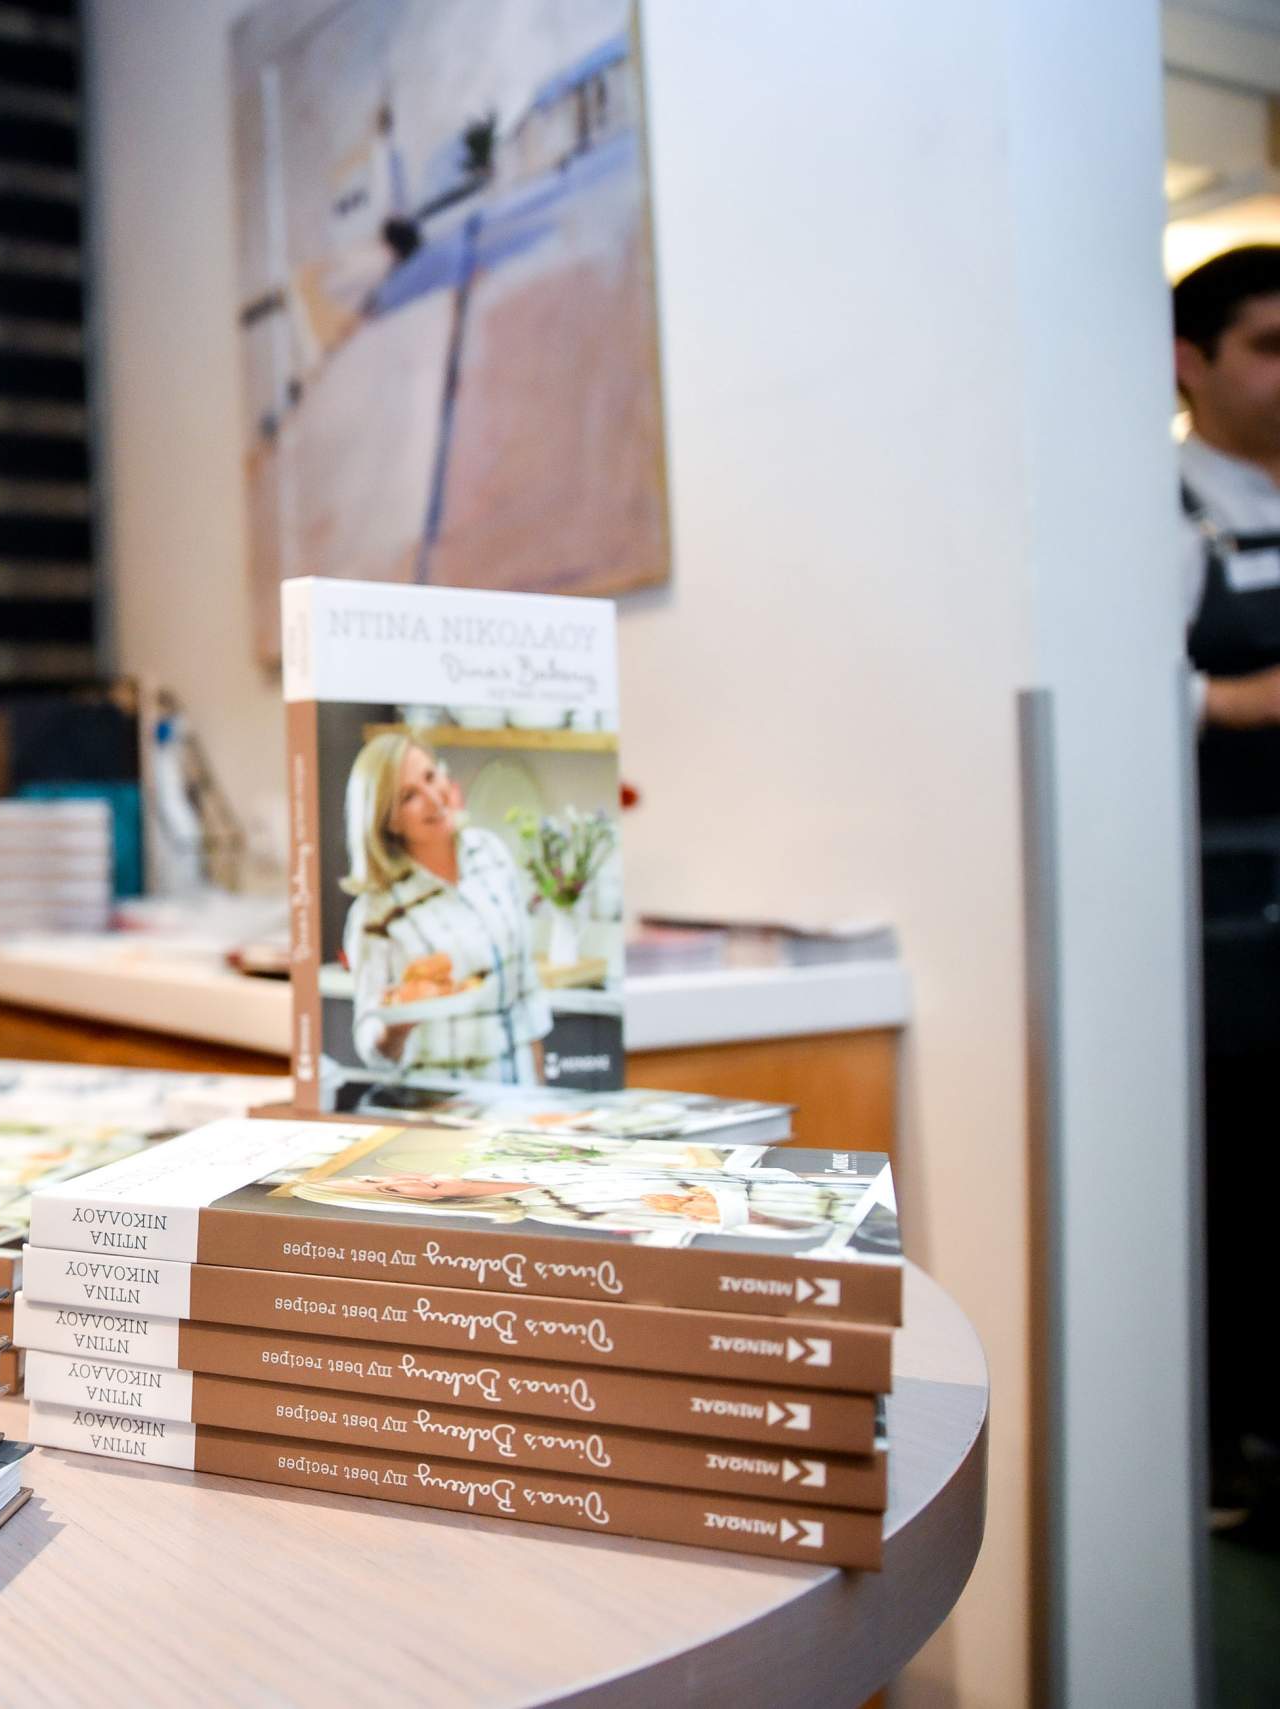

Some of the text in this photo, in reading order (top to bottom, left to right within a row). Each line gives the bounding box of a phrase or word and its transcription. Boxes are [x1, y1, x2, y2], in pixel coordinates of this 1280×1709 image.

[71, 1206, 168, 1231] ΝΙΚΟΛΑΟΥ
[90, 1229, 148, 1251] ΝΤΙΝΑ
[282, 1241, 345, 1261] recipes
[350, 1248, 388, 1268] best
[390, 1251, 417, 1267] my
[65, 1260, 160, 1285] ΝΙΚΟΛΑΟΥ
[83, 1283, 141, 1305] ΝΤΙΝΑ
[274, 1297, 337, 1317] recipes
[341, 1303, 379, 1324] best
[381, 1306, 408, 1323] my
[55, 1310, 149, 1335] ΝΙΚΟΛΑΟΥ
[73, 1332, 130, 1354] ΝΤΙΝΑ
[261, 1350, 323, 1371] recipes
[327, 1357, 363, 1377] best
[366, 1360, 393, 1378] my
[68, 1361, 162, 1388] ΝΙΚΟΛΑΟΥ
[86, 1385, 142, 1407] ΝΤΙΝΑ
[72, 1410, 166, 1438] ΝΙΚΟΛΑΟΥ
[275, 1403, 337, 1424] recipes
[342, 1412, 379, 1432] best
[381, 1416, 408, 1433] my
[90, 1433, 147, 1457] ΝΤΙΝΑ
[277, 1455, 338, 1476] recipes
[343, 1465, 380, 1486] best
[382, 1469, 409, 1487] my
